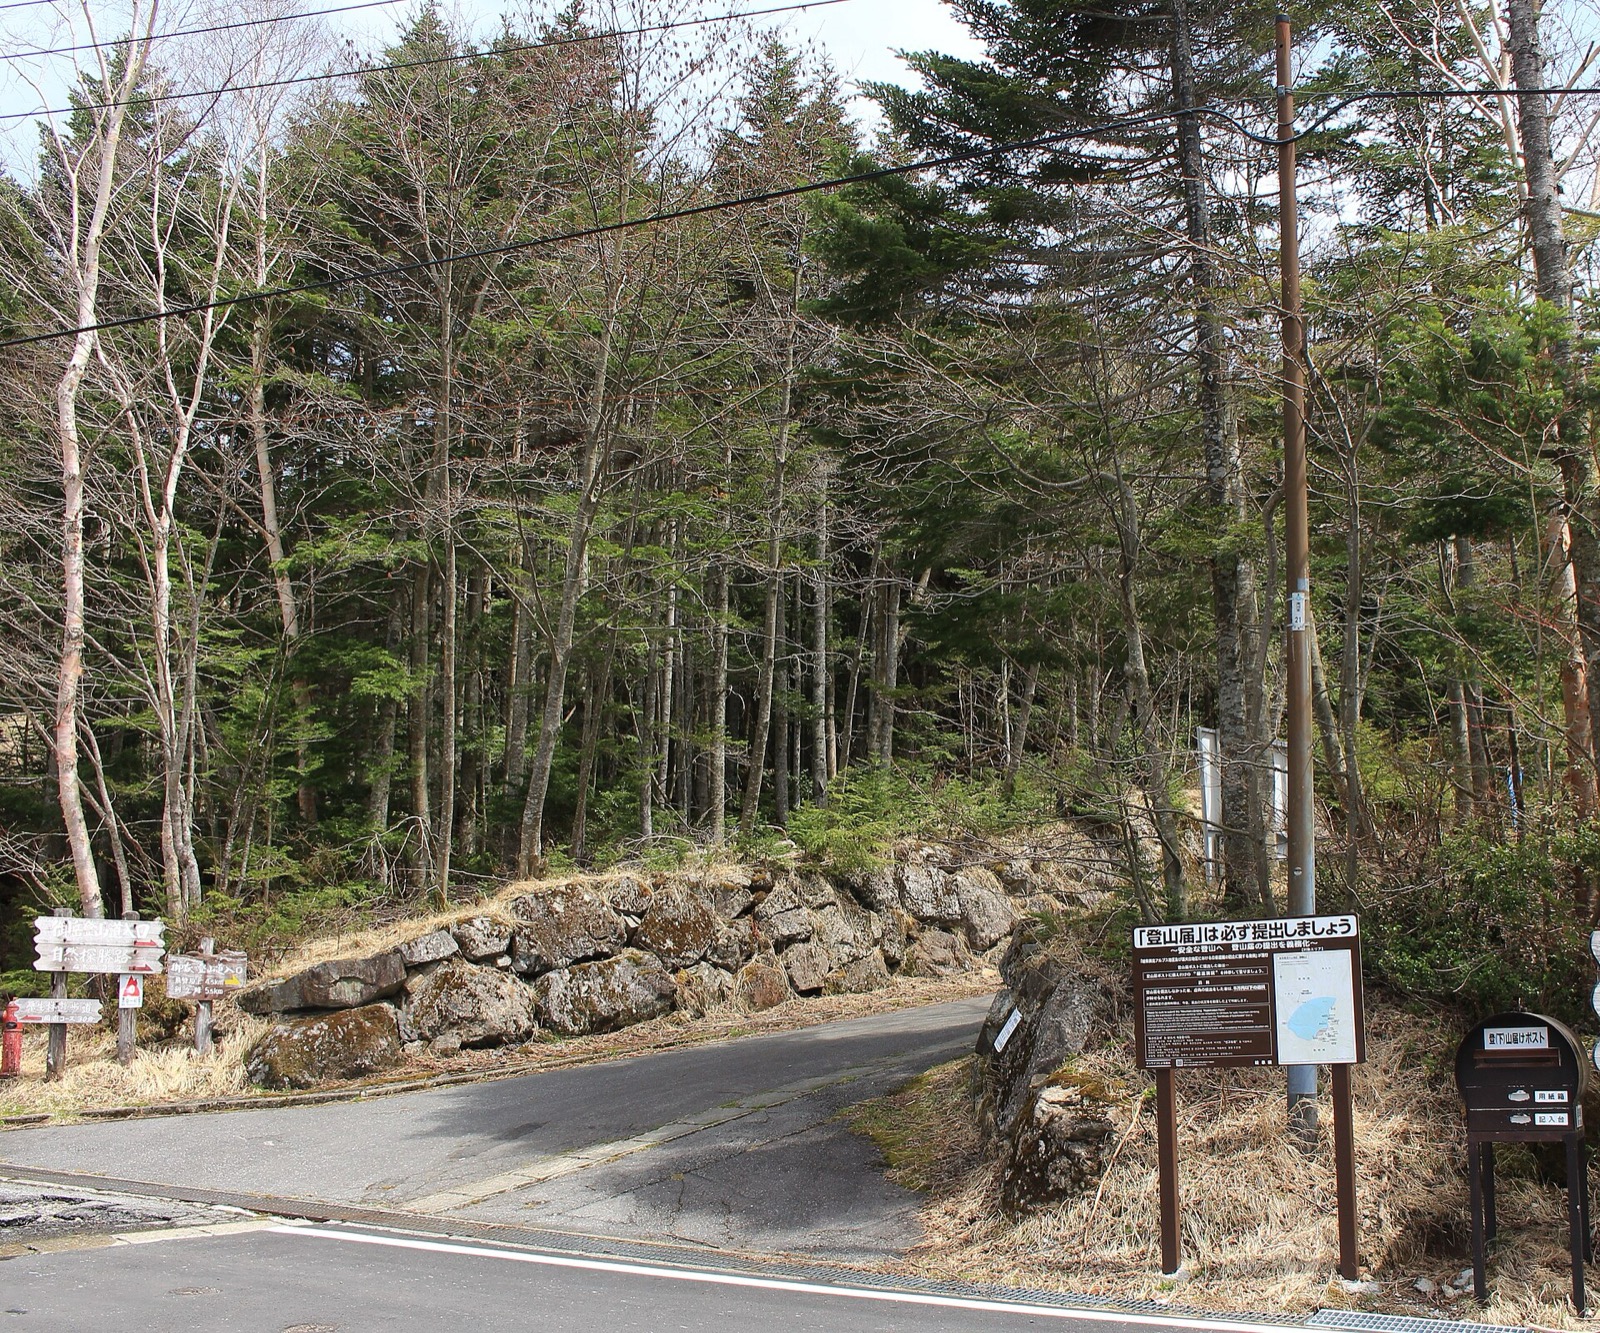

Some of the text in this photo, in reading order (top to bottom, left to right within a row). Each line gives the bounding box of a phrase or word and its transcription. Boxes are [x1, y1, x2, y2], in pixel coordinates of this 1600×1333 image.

[1138, 918, 1351, 946] 「登山届」は必ず提出しましょう
[1488, 1031, 1545, 1045] 登(下)山届けポスト
[1538, 1092, 1565, 1100] 用紙箱
[1538, 1115, 1565, 1123] 記入台
